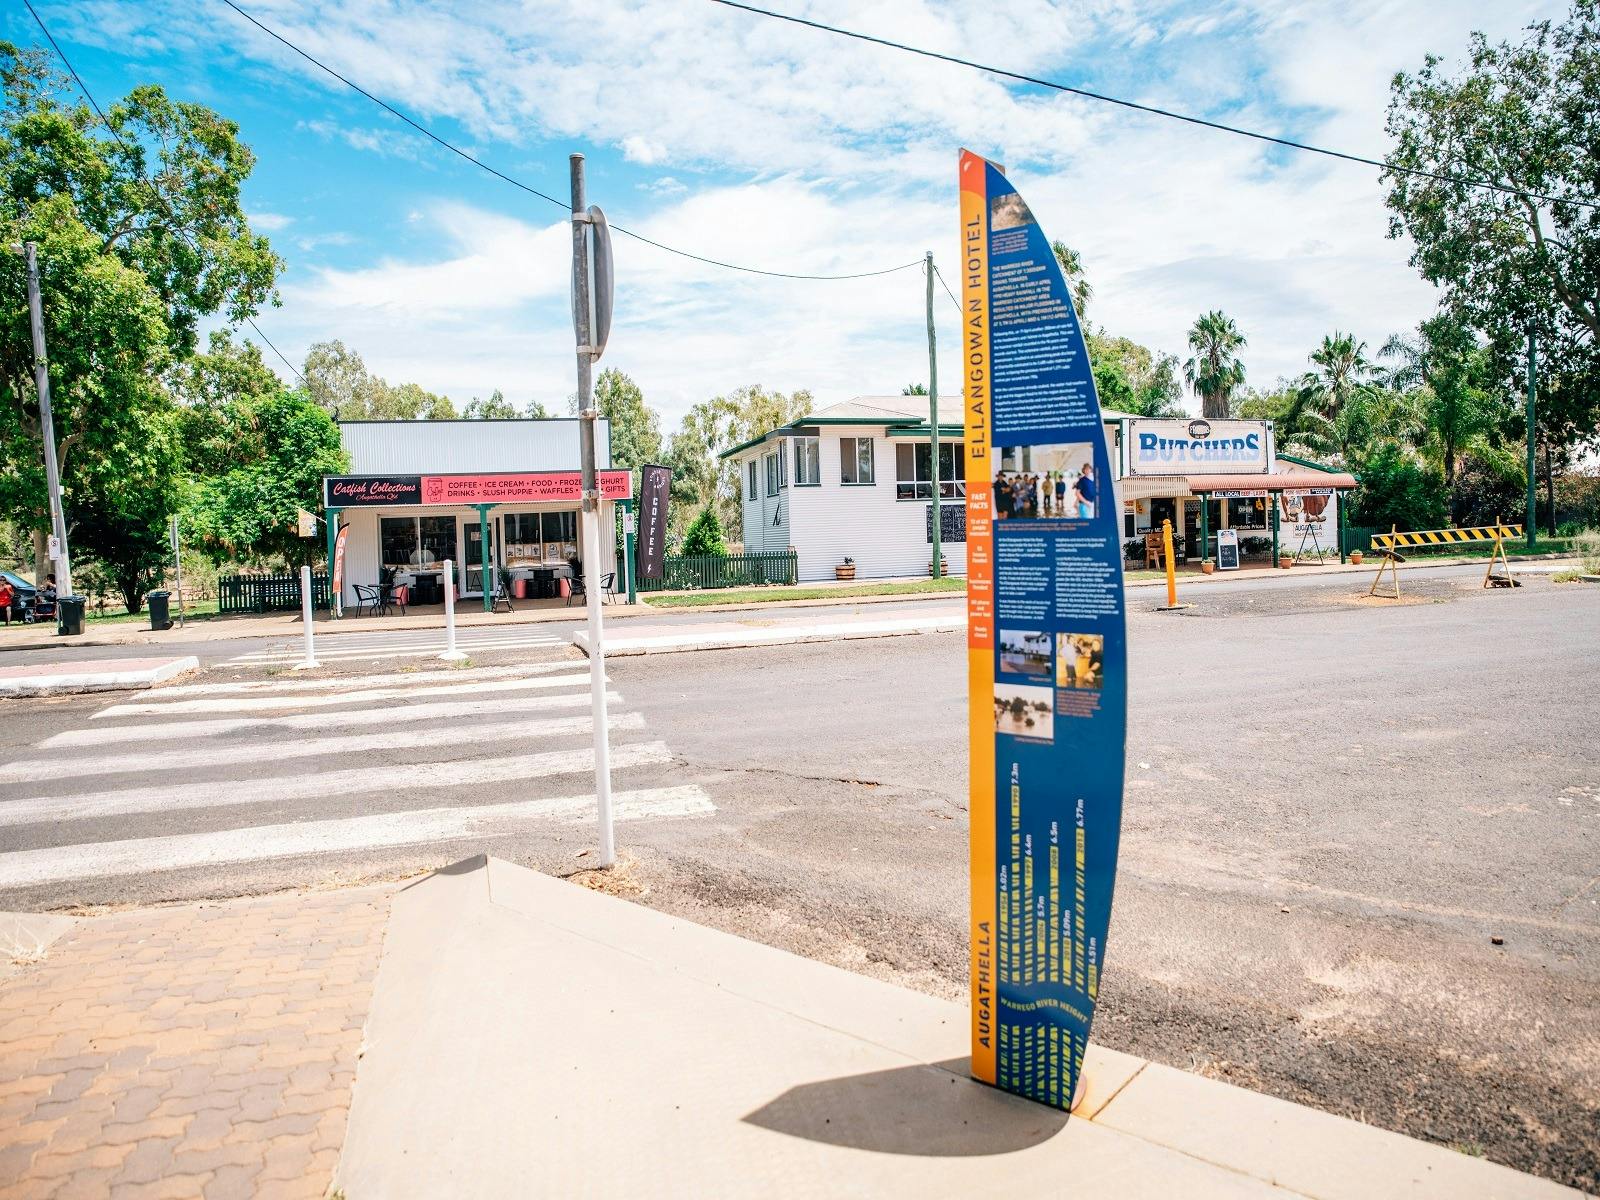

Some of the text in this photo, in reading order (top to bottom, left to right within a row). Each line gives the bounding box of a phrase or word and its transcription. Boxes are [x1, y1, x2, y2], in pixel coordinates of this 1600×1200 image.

[967, 213, 981, 289] HOTEL
[969, 299, 985, 459] ELLANGOWAN
[1139, 433, 1260, 461] BUTCHERS
[334, 481, 416, 496] Catfish Collections
[498, 480, 524, 488] CREAM
[507, 488, 533, 496] PUPPIE
[540, 487, 574, 495] WAFFLES
[970, 502, 988, 510] FACTS
[971, 493, 987, 501] FAST
[648, 497, 659, 556] COFFEE
[1076, 799, 1084, 827] 6.77m
[1024, 834, 1032, 856] 6.4m
[1050, 822, 1058, 844] 6.5m
[1037, 896, 1045, 917] 5.7m
[1088, 937, 1096, 964] 4.51m
[979, 921, 990, 1048] AUGATHELLA
[1001, 997, 1088, 1023] WARREGO RIVER HEIGHT
